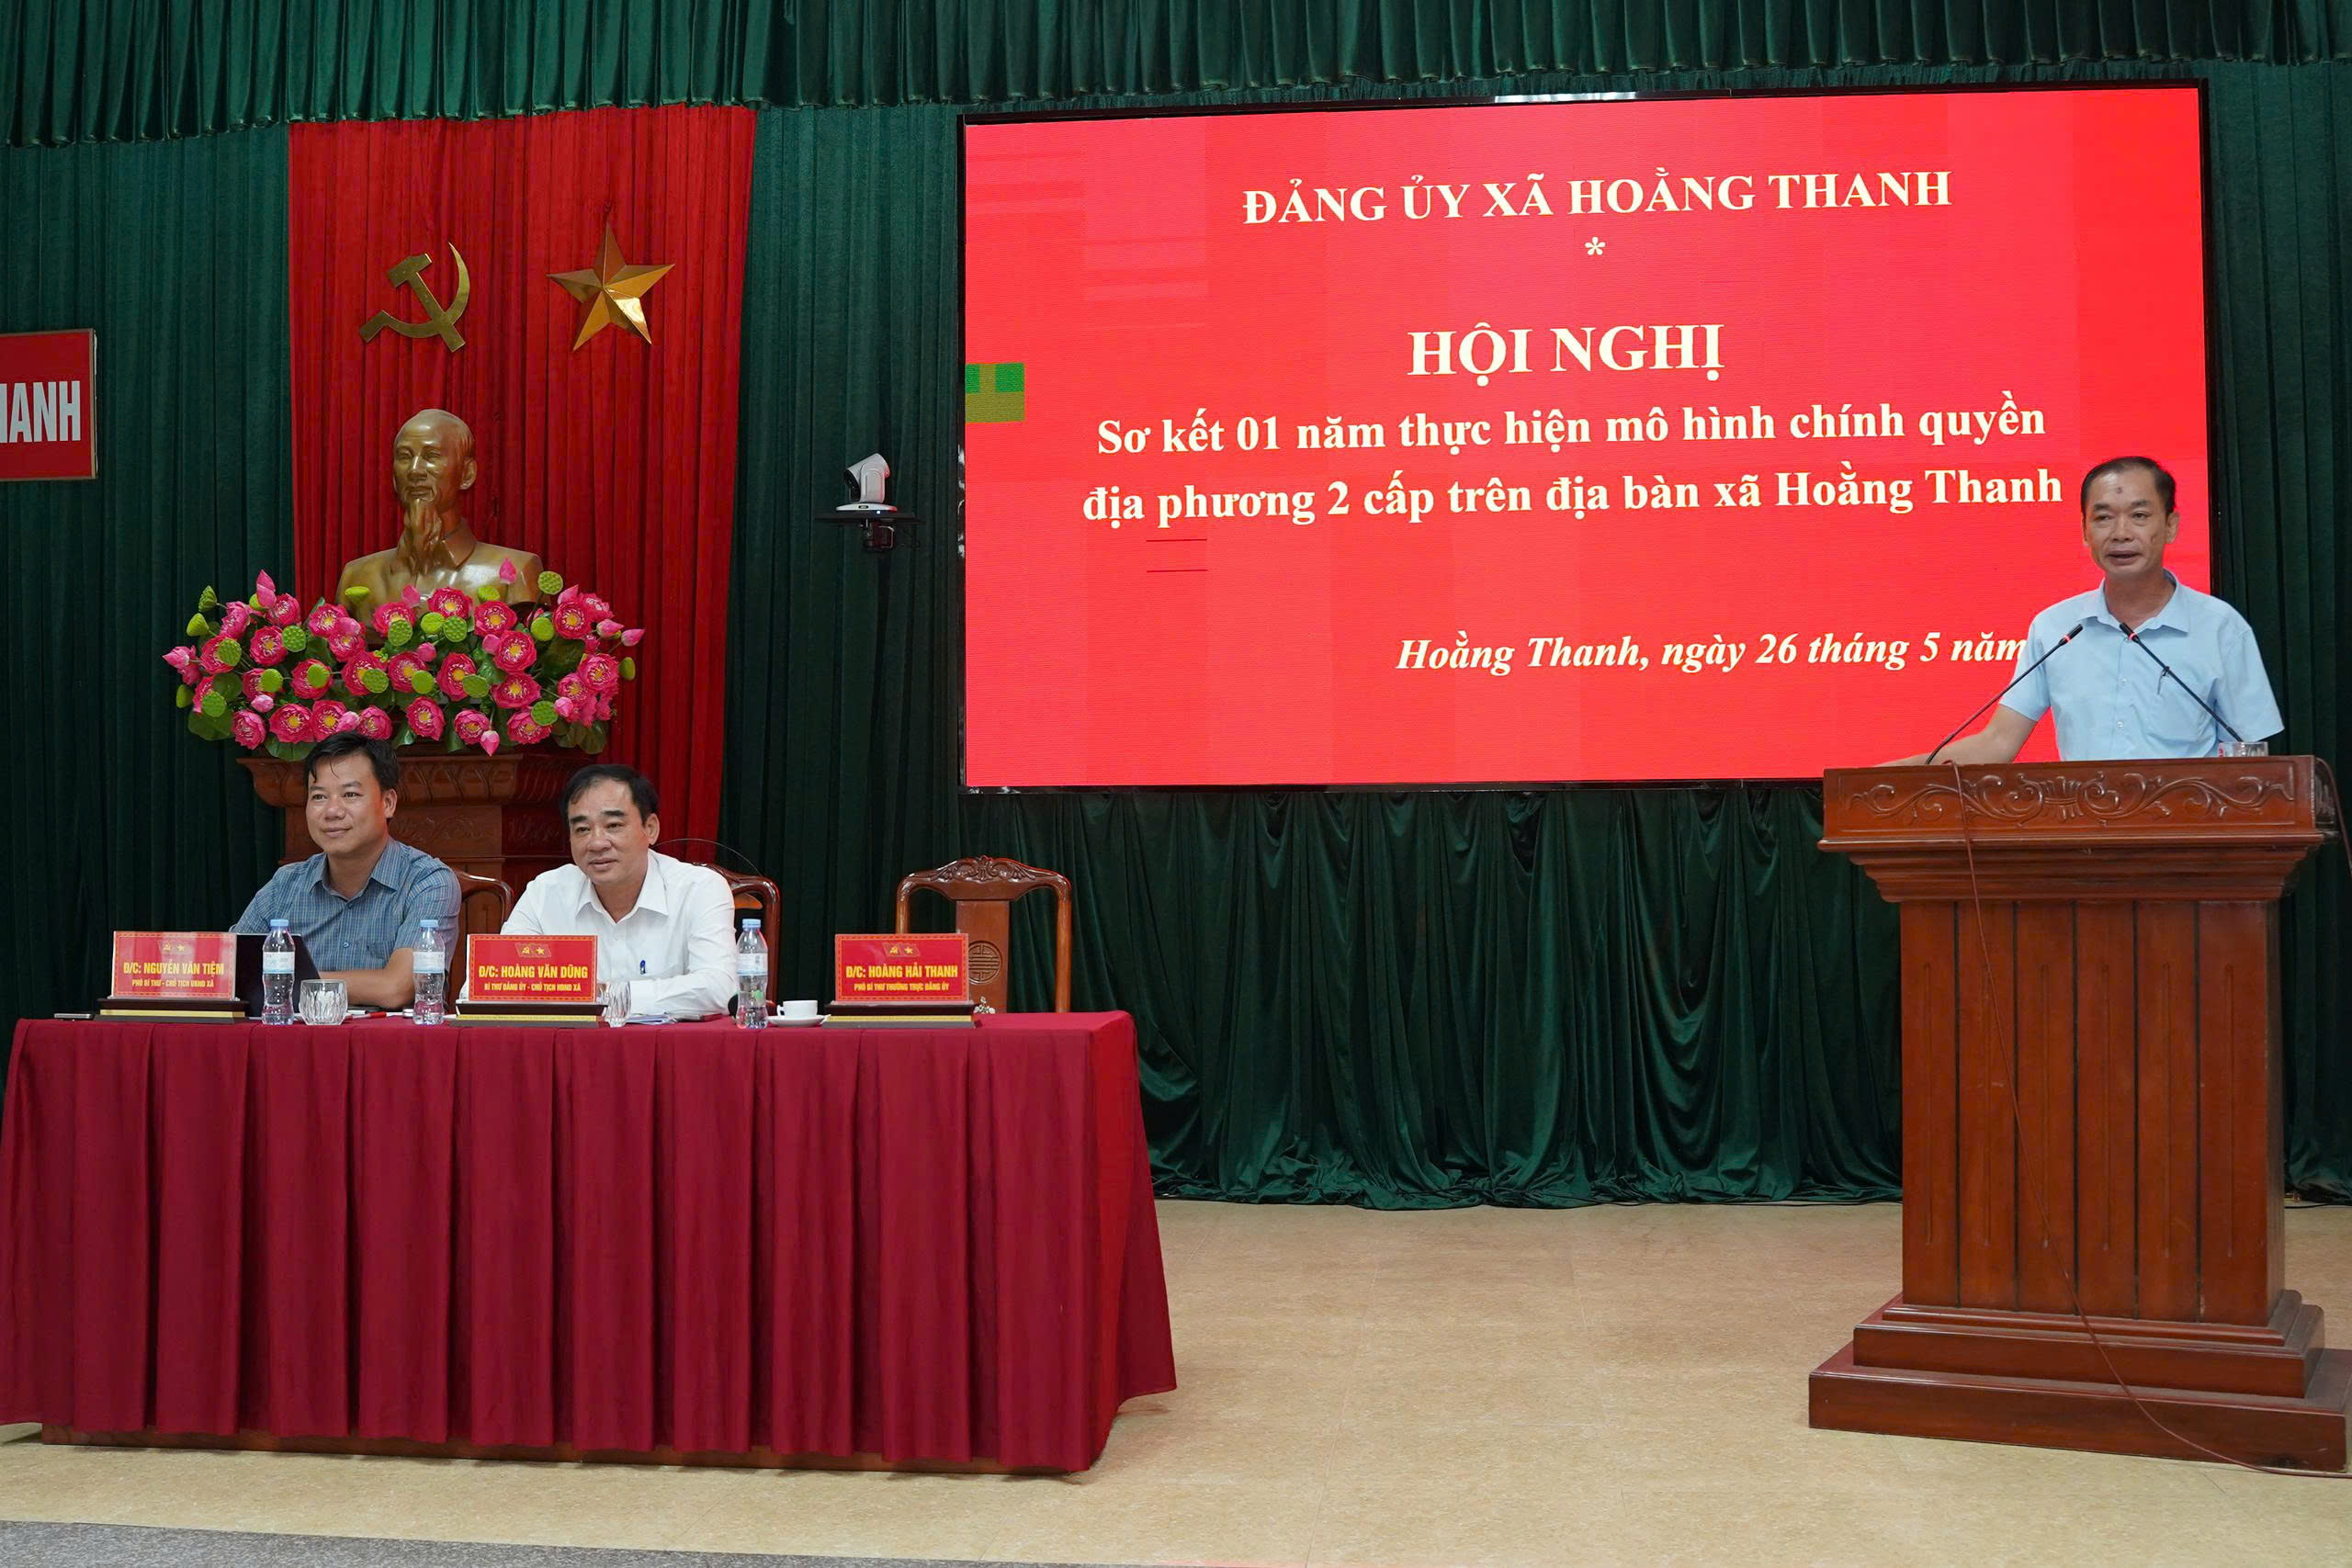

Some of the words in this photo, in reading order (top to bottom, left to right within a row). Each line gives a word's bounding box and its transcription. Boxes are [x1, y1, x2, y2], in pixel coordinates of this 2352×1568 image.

[1242, 178, 1388, 224] ĐẢNG
[1400, 174, 1471, 220] ỦY
[1482, 173, 1555, 218] XÃ
[1566, 166, 1756, 215] HOẰNG
[1768, 171, 1952, 209] THANH
[1407, 321, 1533, 387] HỘI
[1549, 323, 1725, 381] NGHỊ
[1098, 420, 1151, 454] Sơ
[1161, 407, 1225, 453] kết
[1237, 415, 1280, 451] 01
[1296, 415, 1386, 449] năm
[1397, 412, 1491, 456] thực
[1504, 408, 1591, 453] hiện
[1605, 406, 1668, 442] mô
[1681, 405, 1776, 441] hình
[1790, 402, 1905, 439] chính
[1918, 389, 2046, 446] quyền
[1082, 485, 1146, 529] địa
[1157, 484, 1316, 528] phương
[1327, 480, 1350, 515] 2
[1363, 469, 1434, 524] cấp
[1447, 477, 1532, 513] trên
[1545, 475, 1611, 520] địa
[1622, 474, 1701, 510] bàn
[1713, 474, 1762, 507] xã
[1775, 460, 1914, 514] Hoằng
[1924, 468, 2063, 503] Thanh
[1395, 630, 1516, 677] Hoằng
[1527, 635, 1650, 671] Thanh,
[1661, 634, 1747, 673] ngày
[1754, 633, 1799, 664] 26
[1807, 632, 1910, 671] tháng
[1919, 631, 1941, 662] 5
[1950, 631, 2027, 662] năm
[182, 960, 200, 975] VĂN
[478, 965, 498, 977] Đ/C:
[501, 964, 535, 978] HOÀNG
[537, 964, 558, 978] VĂN
[560, 964, 588, 978] DŨNG
[845, 965, 865, 978] Đ/C:
[868, 963, 903, 978] HOÀNG
[905, 961, 922, 978] HẢI
[924, 964, 958, 978] THANH
